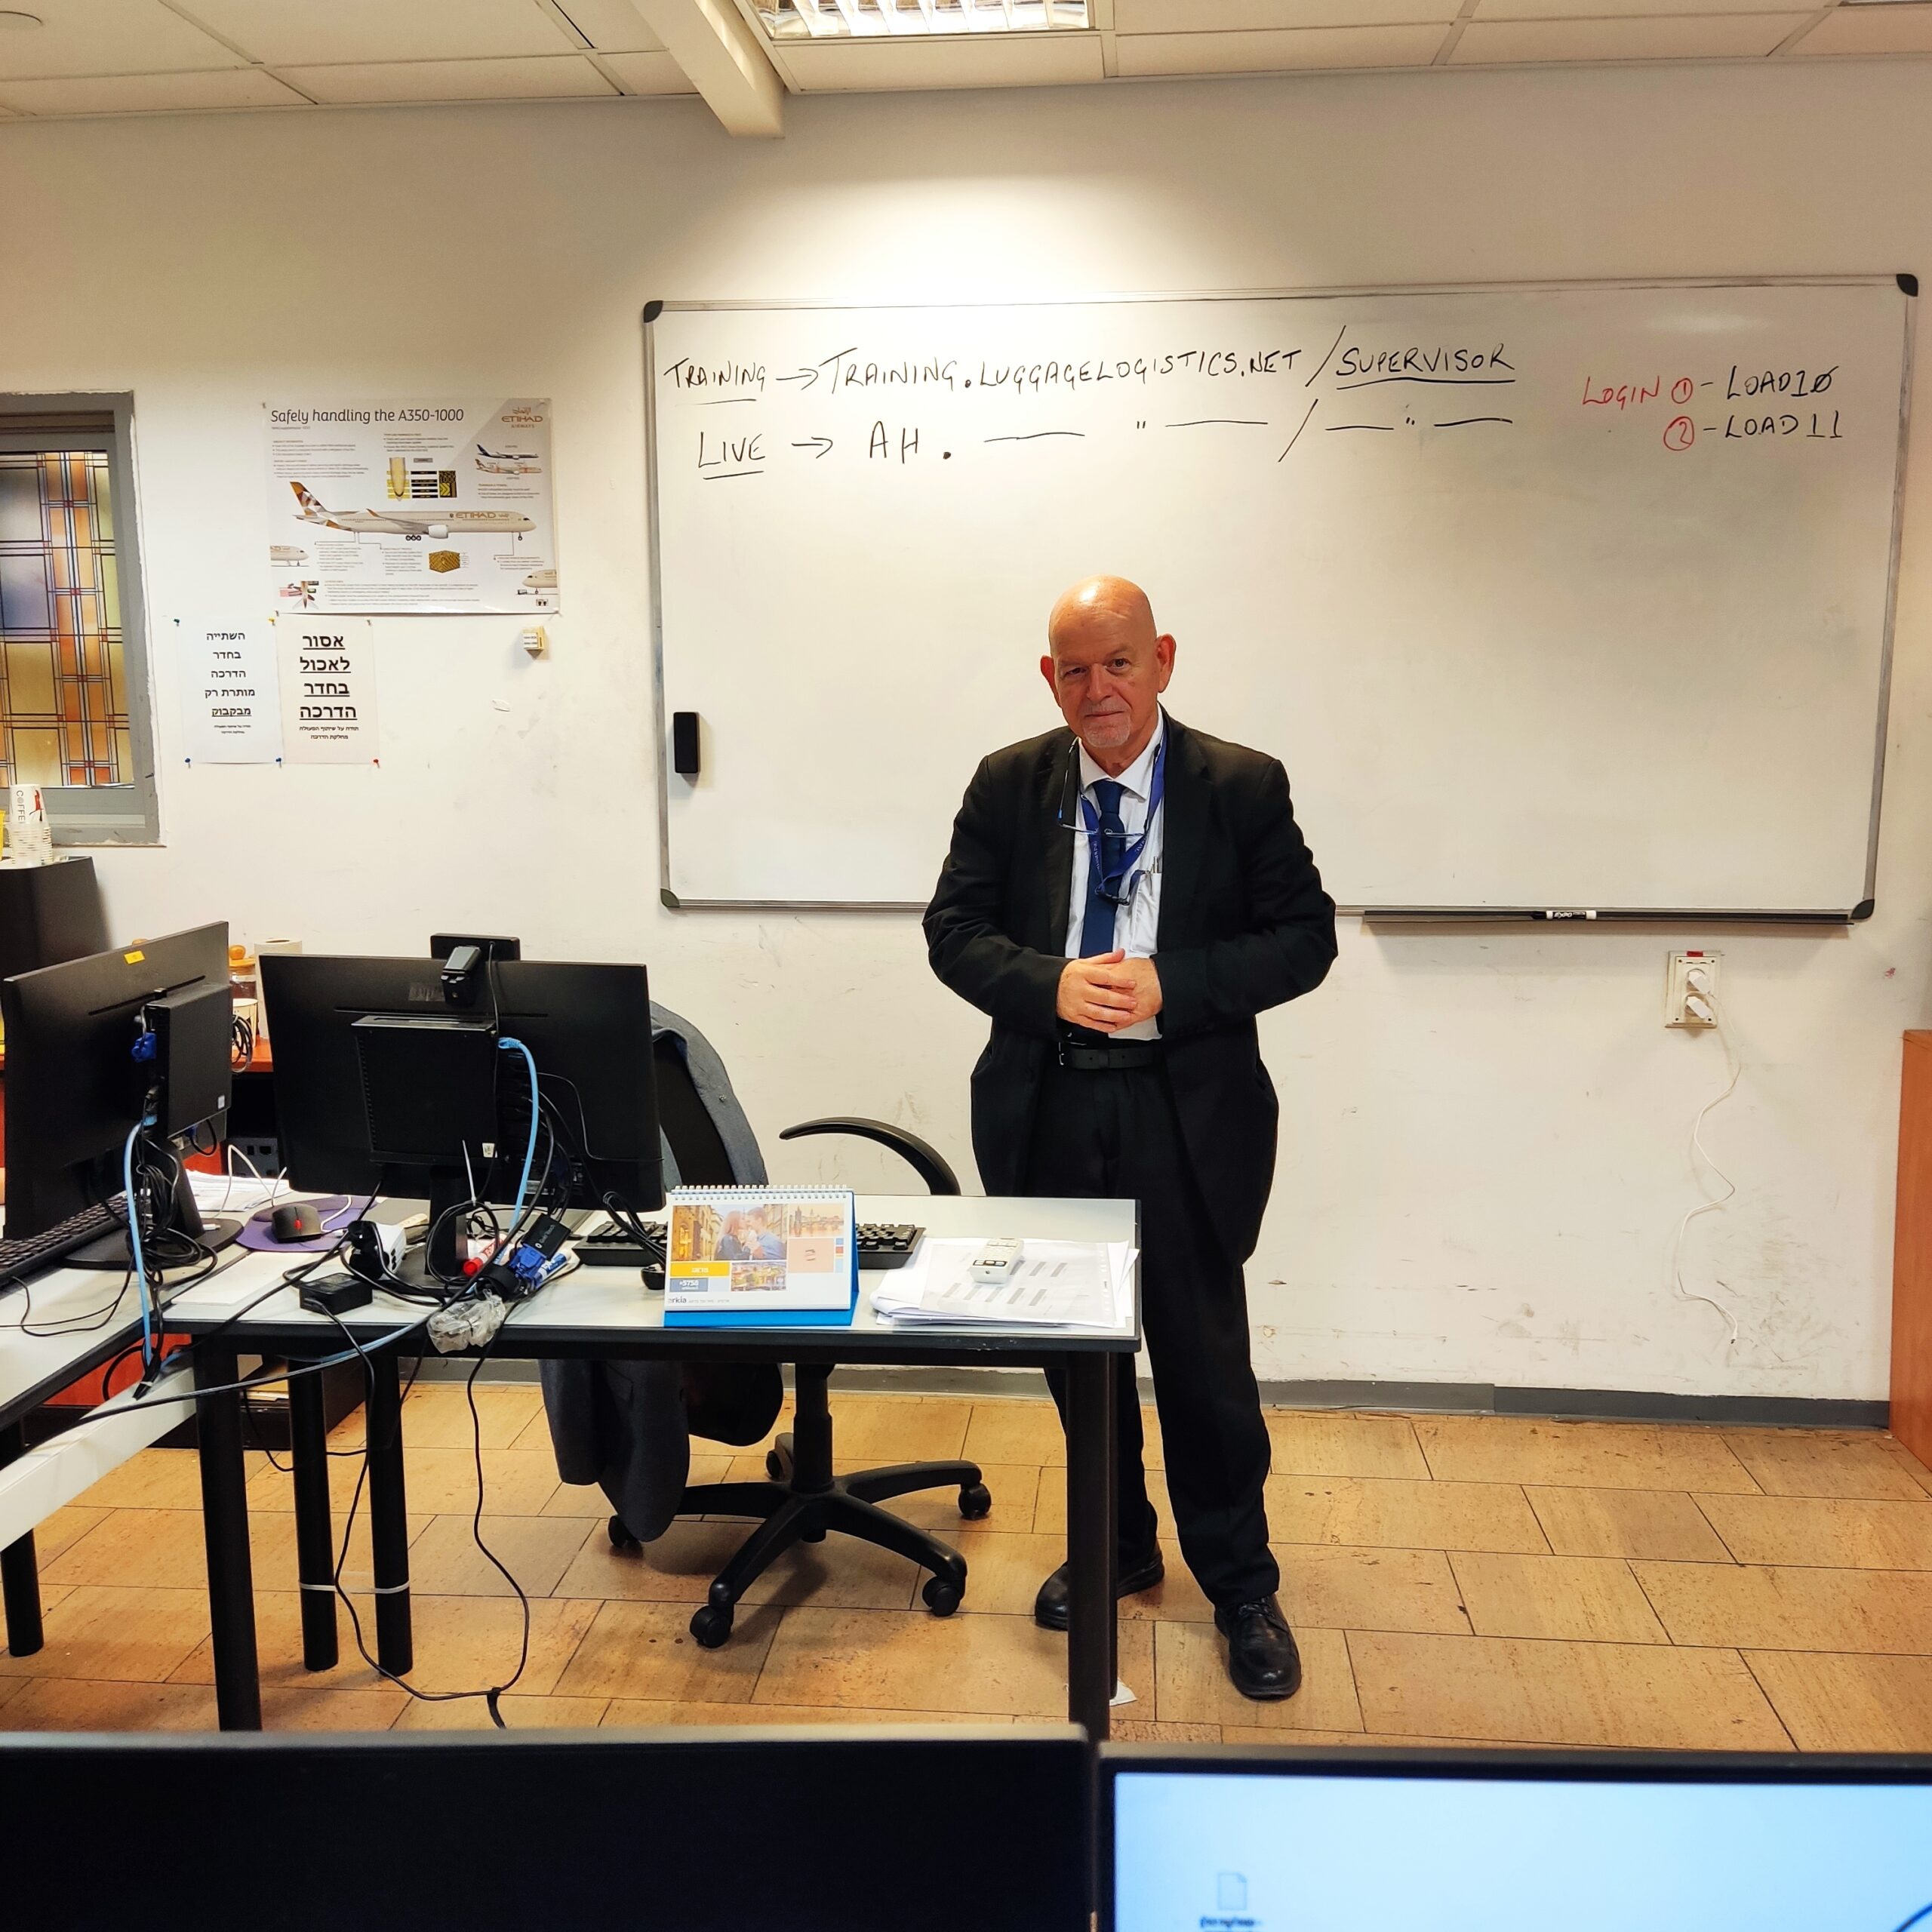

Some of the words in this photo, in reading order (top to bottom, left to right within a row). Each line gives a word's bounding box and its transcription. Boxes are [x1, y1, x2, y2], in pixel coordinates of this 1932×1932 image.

[663, 358, 765, 391] TRAINING
[1583, 376, 1660, 410] LOGIN
[271, 410, 309, 424] Safely
[312, 409, 371, 424] handling
[374, 409, 395, 421] the
[398, 409, 464, 422] A350-1000
[697, 432, 765, 467] LIVE
[206, 632, 245, 641] השתייה
[303, 635, 344, 648] אסור
[213, 651, 242, 660] בחדר
[300, 657, 350, 671] לאכול
[211, 669, 246, 678] הדרכה
[205, 688, 218, 699] רק
[221, 688, 255, 697] מותרת
[303, 682, 350, 694] בחדר
[211, 708, 251, 717] מבקבוק
[300, 706, 357, 718] הדרכה
[16, 790, 26, 823] COFFE
